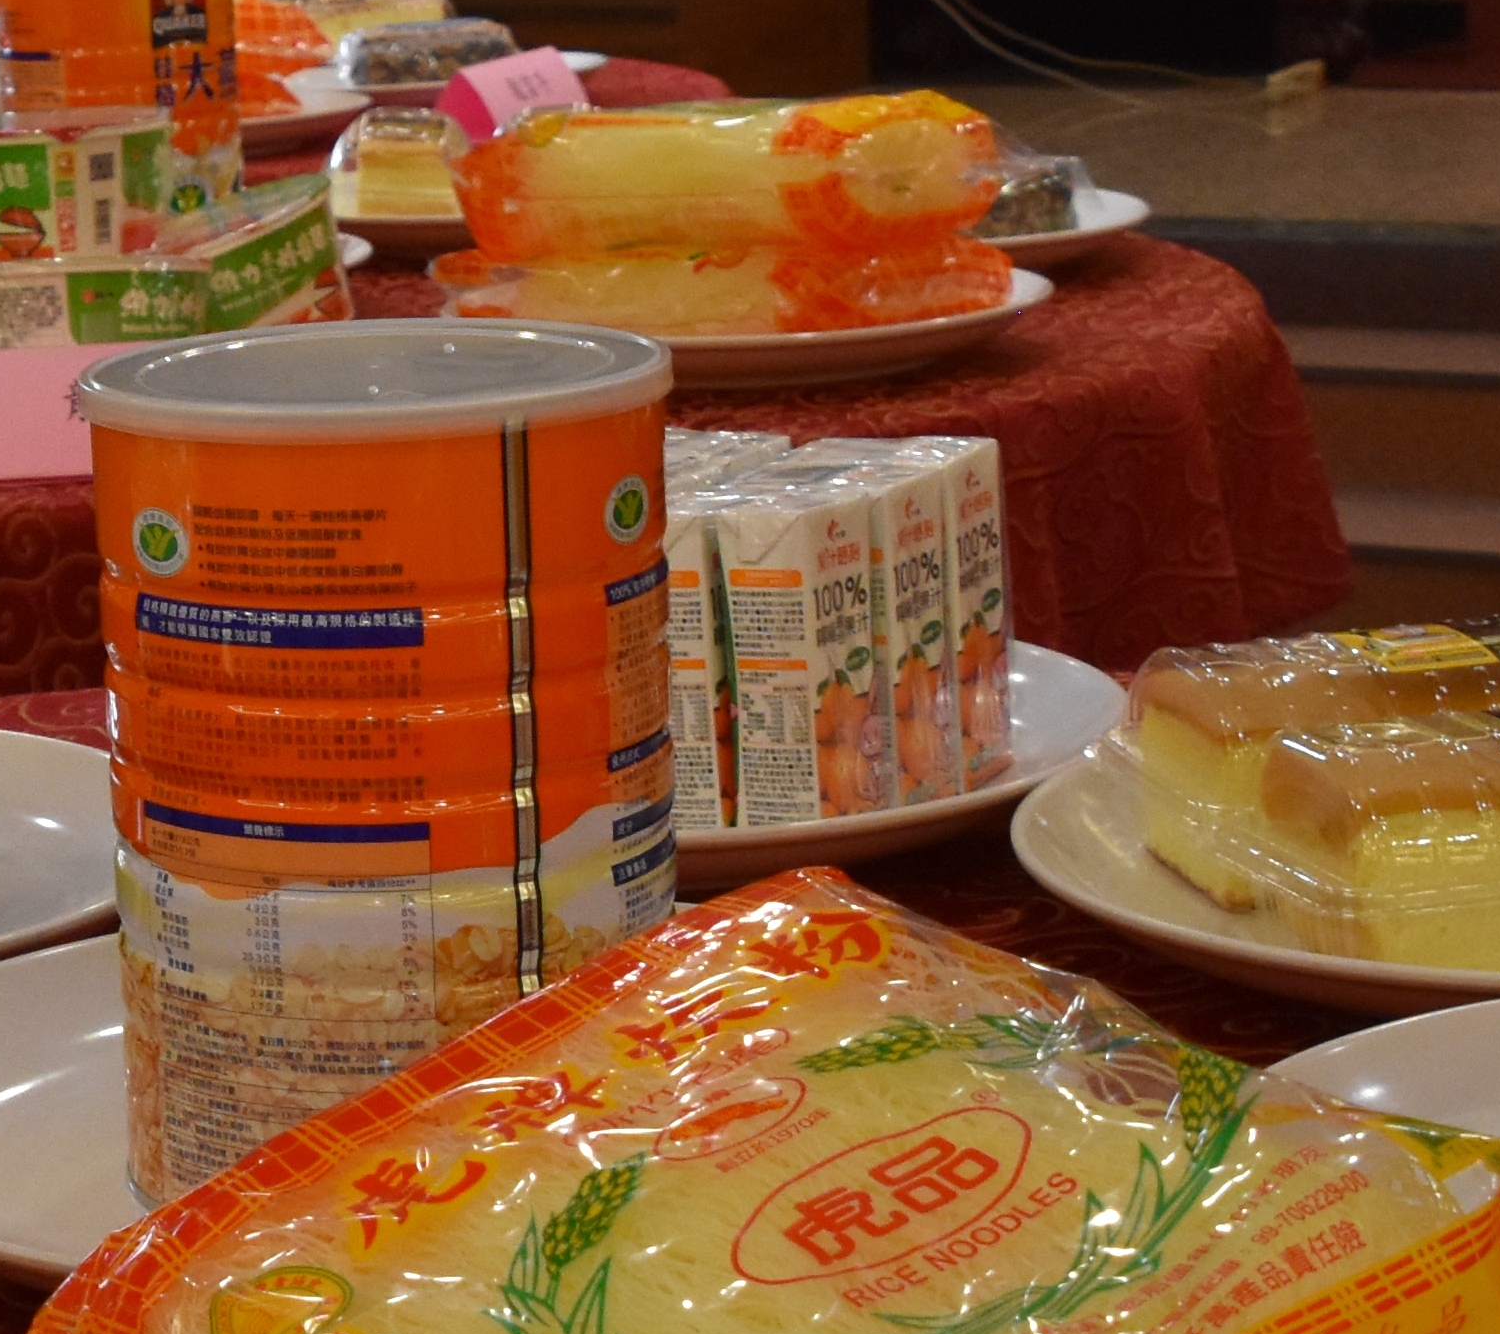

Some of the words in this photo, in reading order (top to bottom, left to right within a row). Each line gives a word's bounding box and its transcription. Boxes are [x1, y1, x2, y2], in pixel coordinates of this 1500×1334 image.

[956, 517, 999, 569] 100%
[813, 572, 868, 621] 100%
[893, 548, 941, 597] 100%
[781, 1133, 1000, 1266] 虎品
[841, 1263, 928, 1310] RICE
[921, 1168, 1080, 1278] NOODLES
